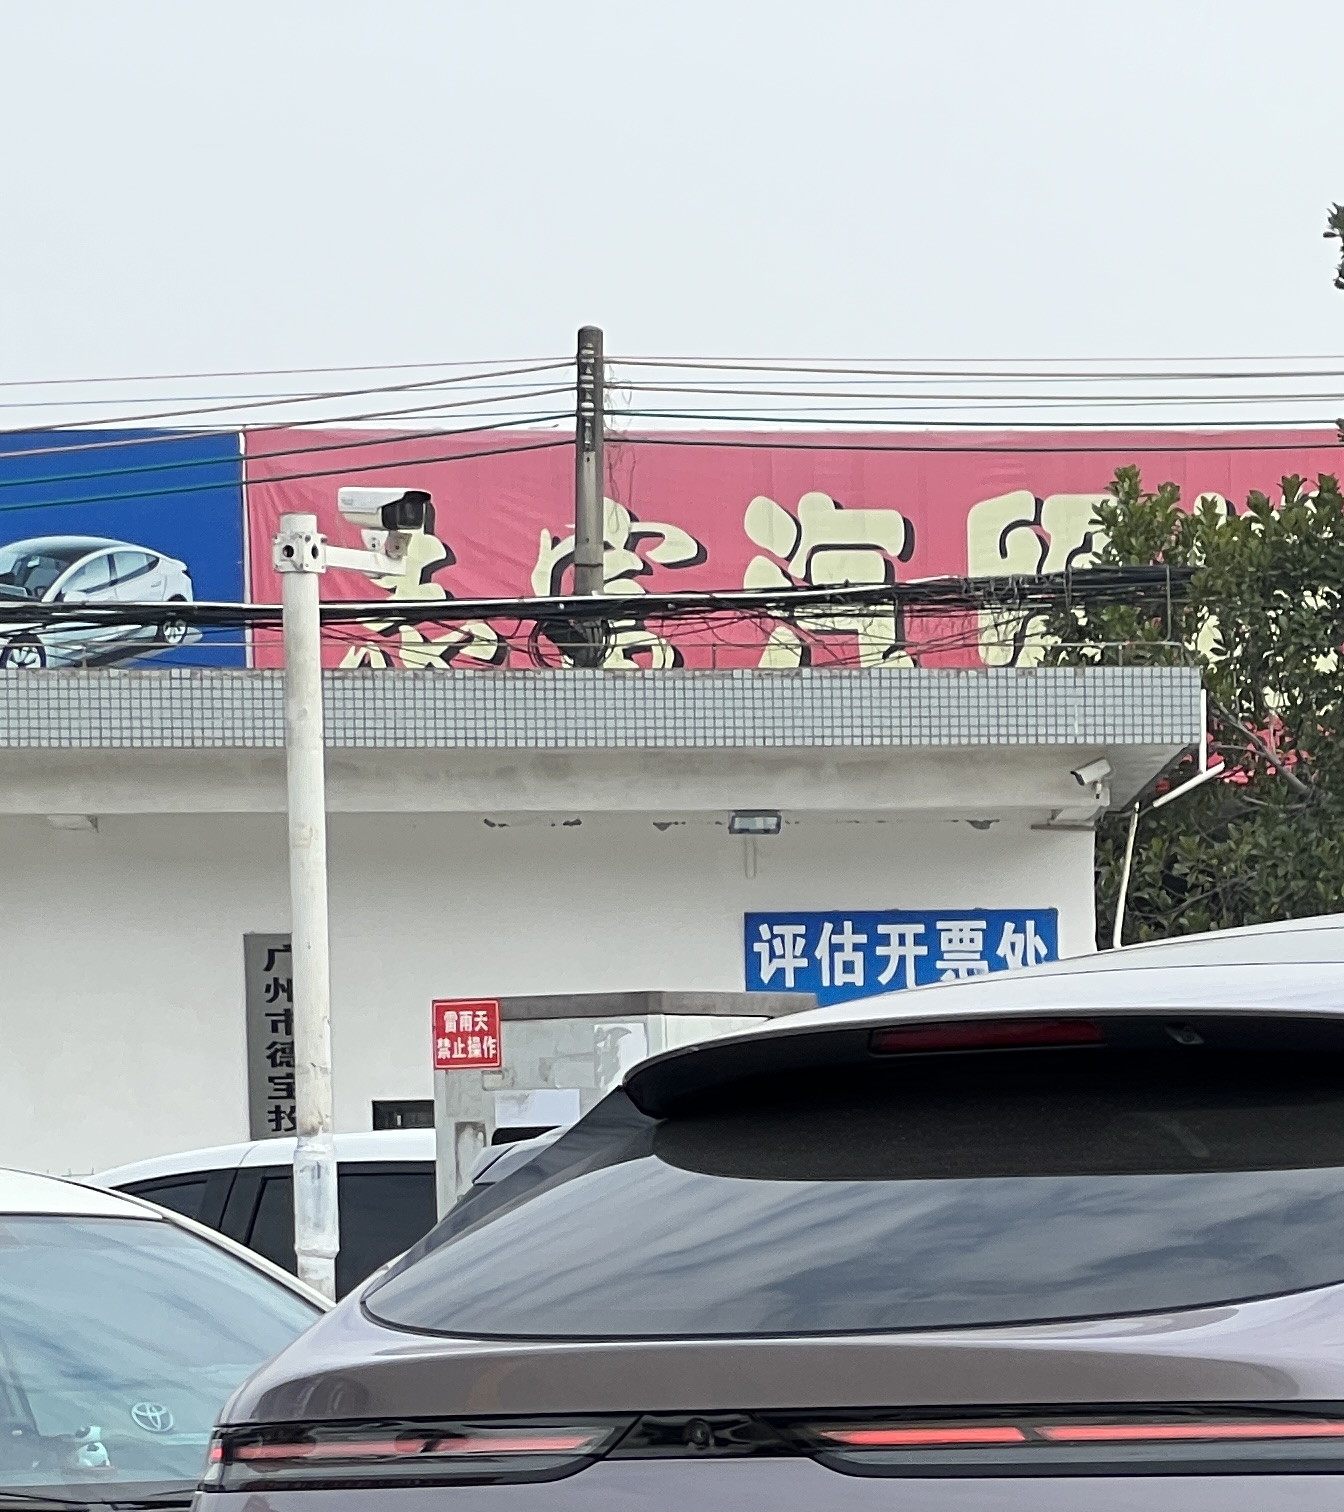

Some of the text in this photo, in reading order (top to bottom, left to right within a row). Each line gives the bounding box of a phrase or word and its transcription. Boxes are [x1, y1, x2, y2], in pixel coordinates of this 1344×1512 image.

[753, 920, 1049, 990] 评估开票处
[443, 1010, 489, 1034] 雷雨天
[436, 1036, 499, 1060] 禁止操作
